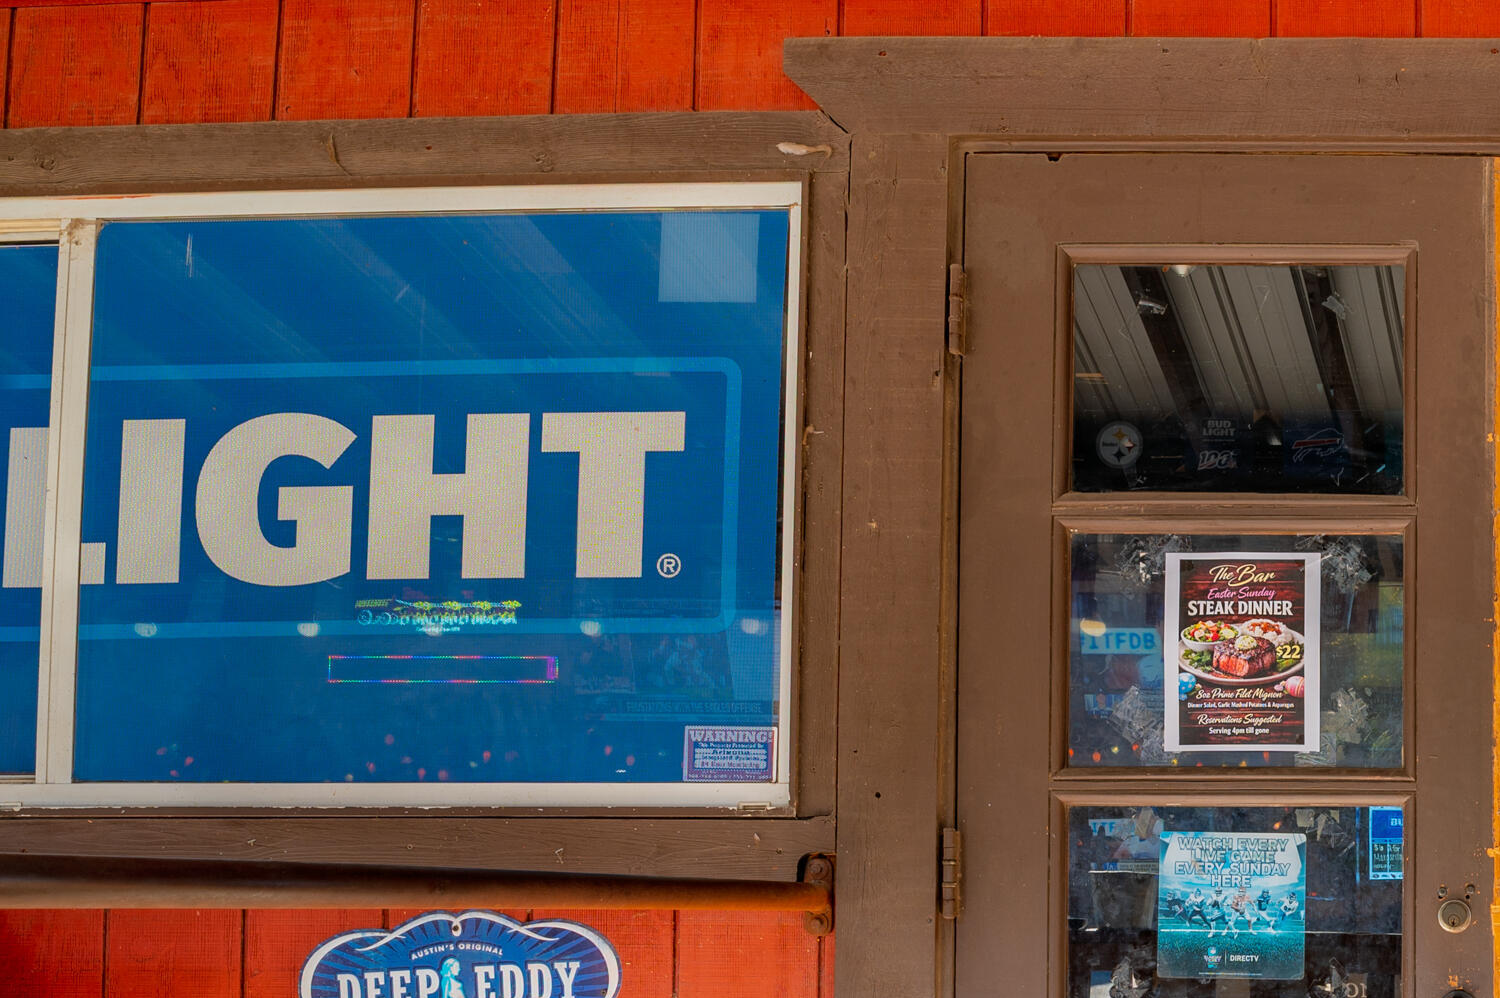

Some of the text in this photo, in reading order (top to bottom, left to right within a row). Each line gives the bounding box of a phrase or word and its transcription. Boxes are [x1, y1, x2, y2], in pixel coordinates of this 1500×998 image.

[1209, 564, 1276, 587] The Bar
[1207, 587, 1276, 600] Easter Sunday
[1187, 600, 1293, 616] STEAK DINNER
[1275, 645, 1301, 659] $22
[1211, 687, 1234, 699] Prime
[1235, 688, 1251, 699] Filet
[1252, 688, 1282, 701] Mignon
[1197, 713, 1283, 726] Reservations Suggested
[689, 730, 773, 743] WARNING!
[1209, 727, 1231, 735] Serving
[1178, 837, 1289, 852] WATCH EVERY
[1191, 849, 1276, 863] LIVE GAME
[1174, 861, 1225, 875] EVERY
[1229, 862, 1291, 876] SUNDAY
[1210, 874, 1251, 888] HERE
[410, 943, 504, 961] AUSTIN'S ORIGINAL
[1229, 954, 1259, 962] DIRECTV
